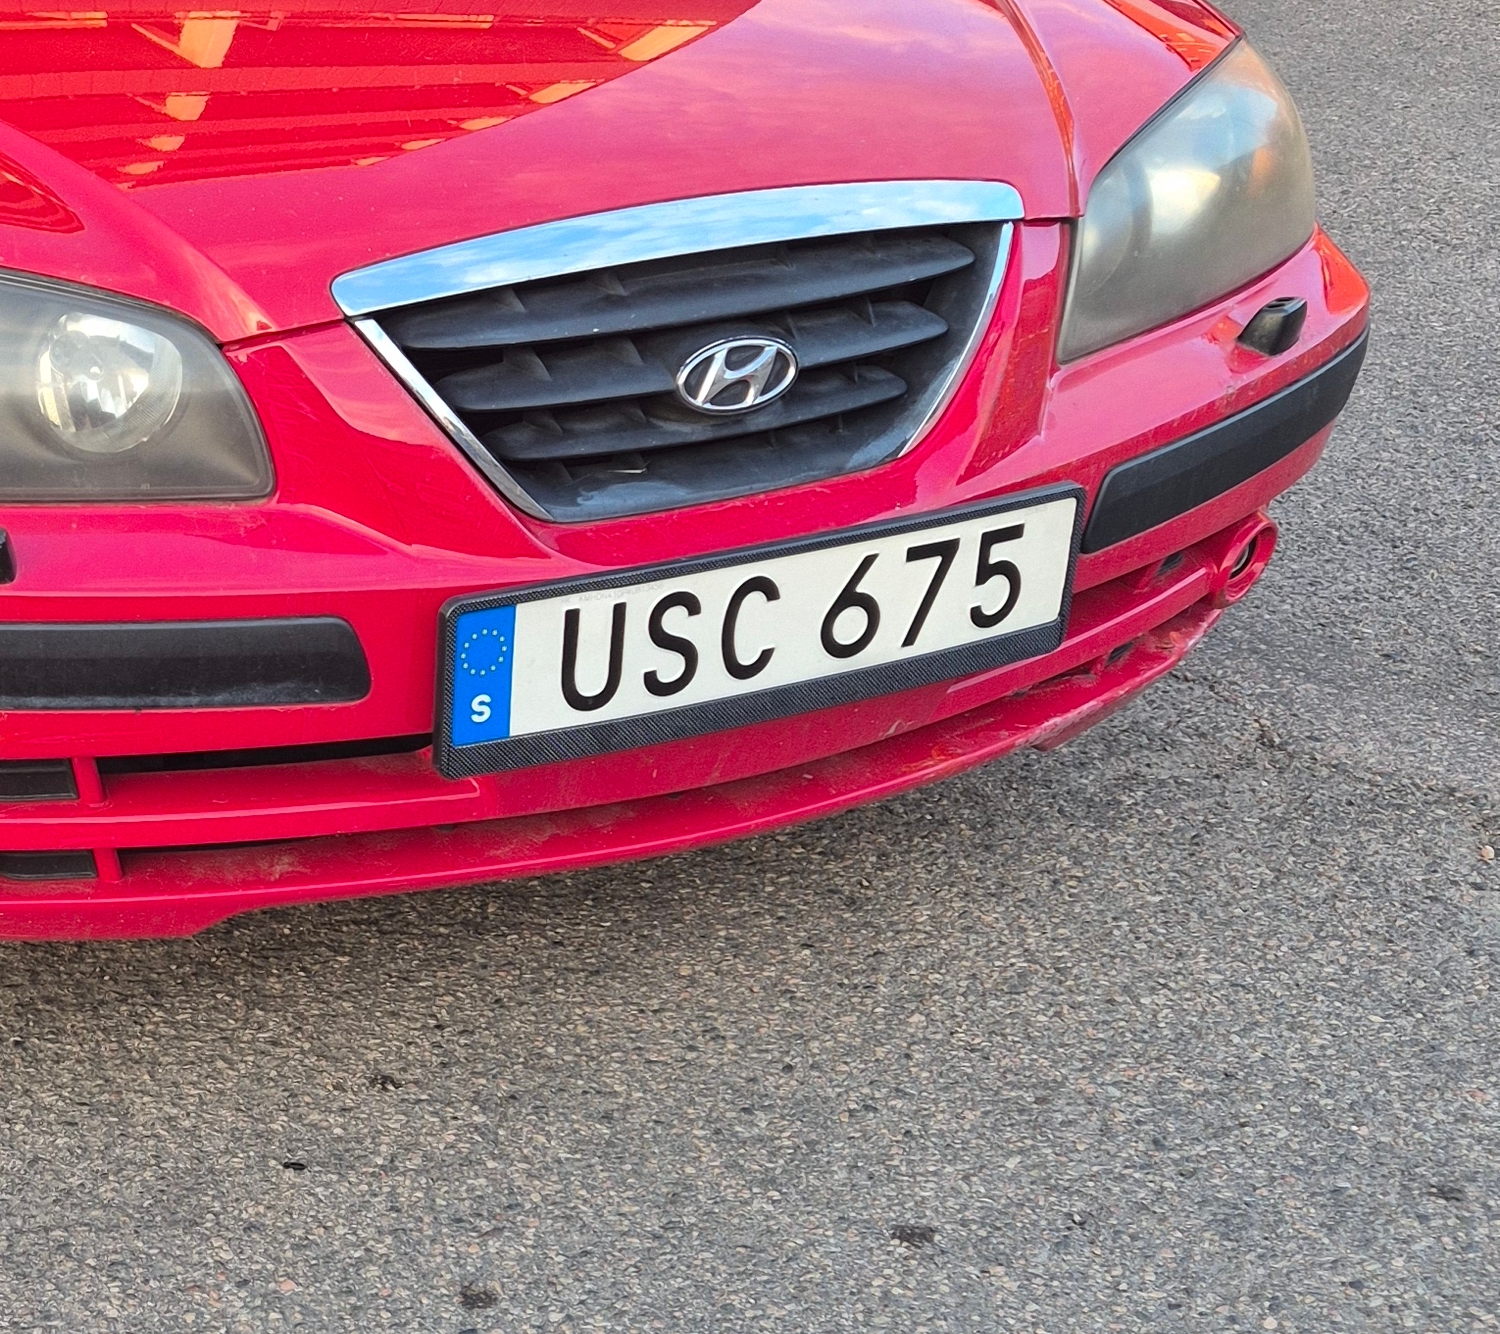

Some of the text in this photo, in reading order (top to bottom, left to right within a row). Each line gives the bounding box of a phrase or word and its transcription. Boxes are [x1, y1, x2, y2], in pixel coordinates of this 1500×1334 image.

[561, 522, 1026, 712] USC 675
[471, 694, 492, 723] S
